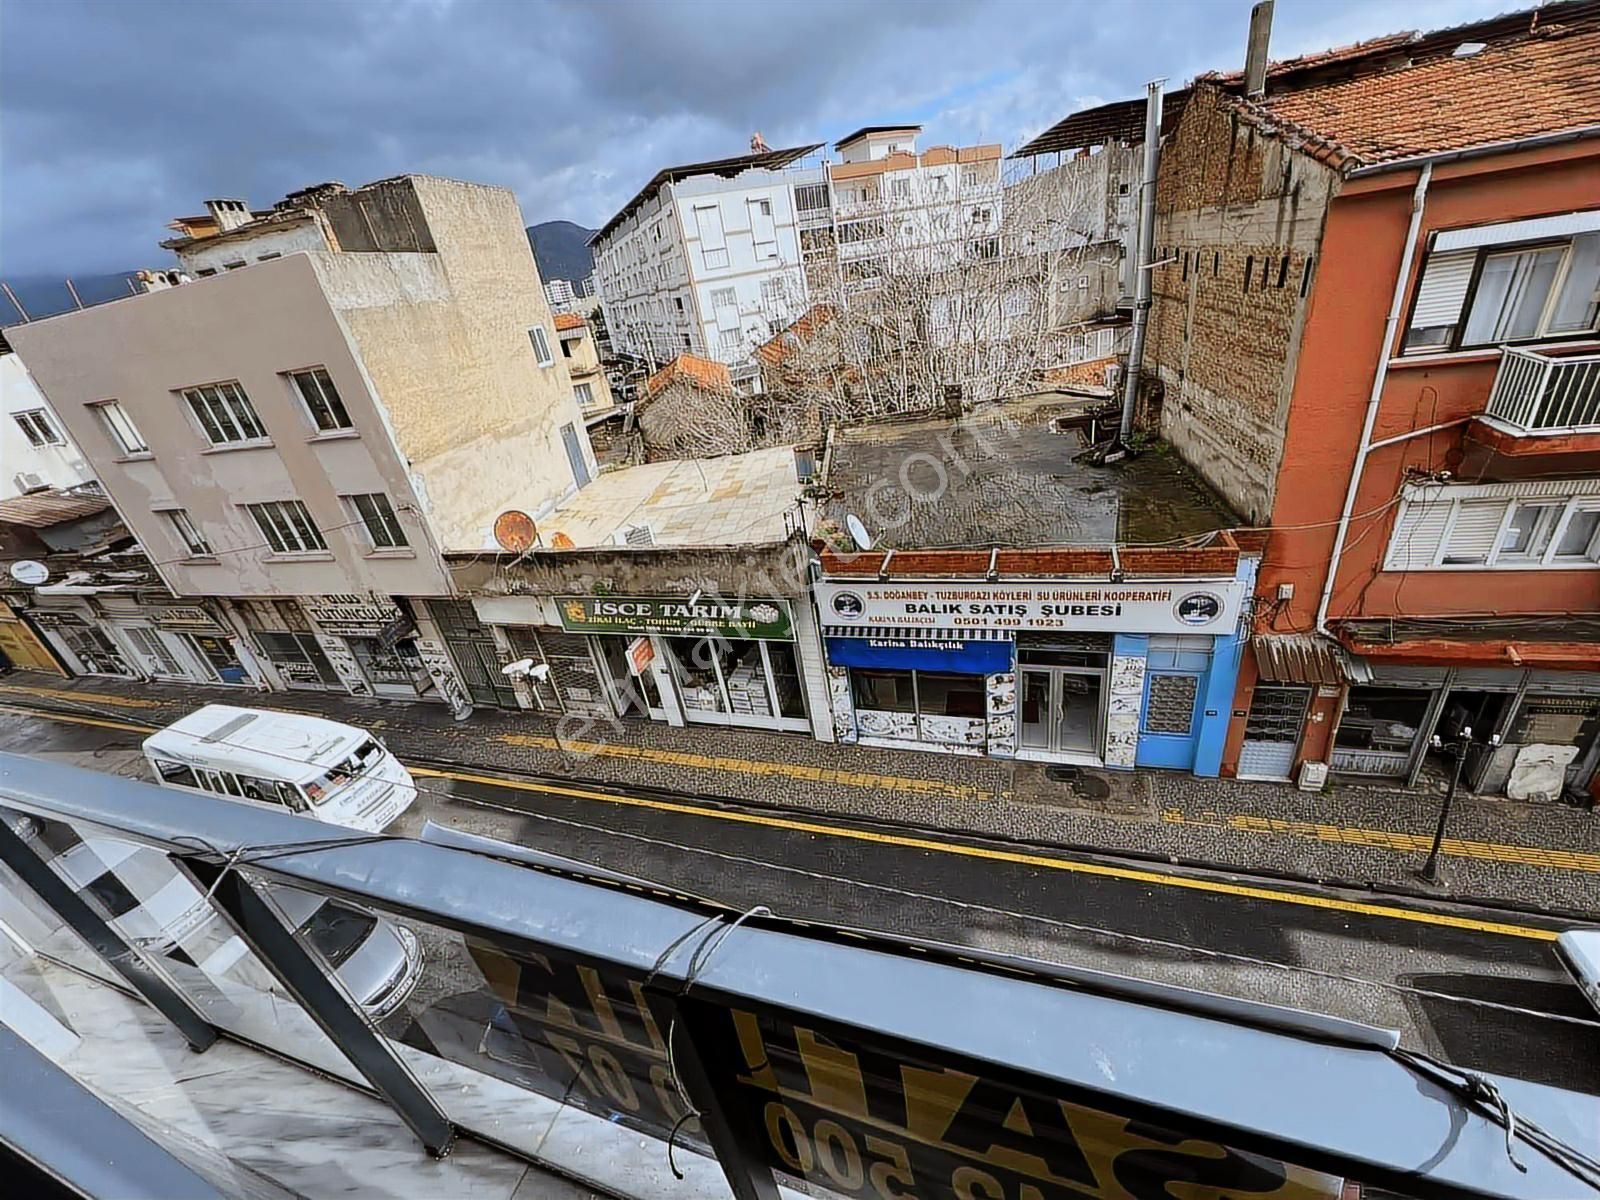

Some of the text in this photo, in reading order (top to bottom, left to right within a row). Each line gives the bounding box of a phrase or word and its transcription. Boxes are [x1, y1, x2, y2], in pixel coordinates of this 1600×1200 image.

[1036, 591, 1051, 602] SU
[593, 599, 742, 619] İSCE TARIM
[904, 602, 1122, 618] BALIK SATIŞ ŞUBESİ
[953, 617, 988, 626] 0501
[993, 617, 1021, 627] 499
[869, 639, 906, 648] Karina
